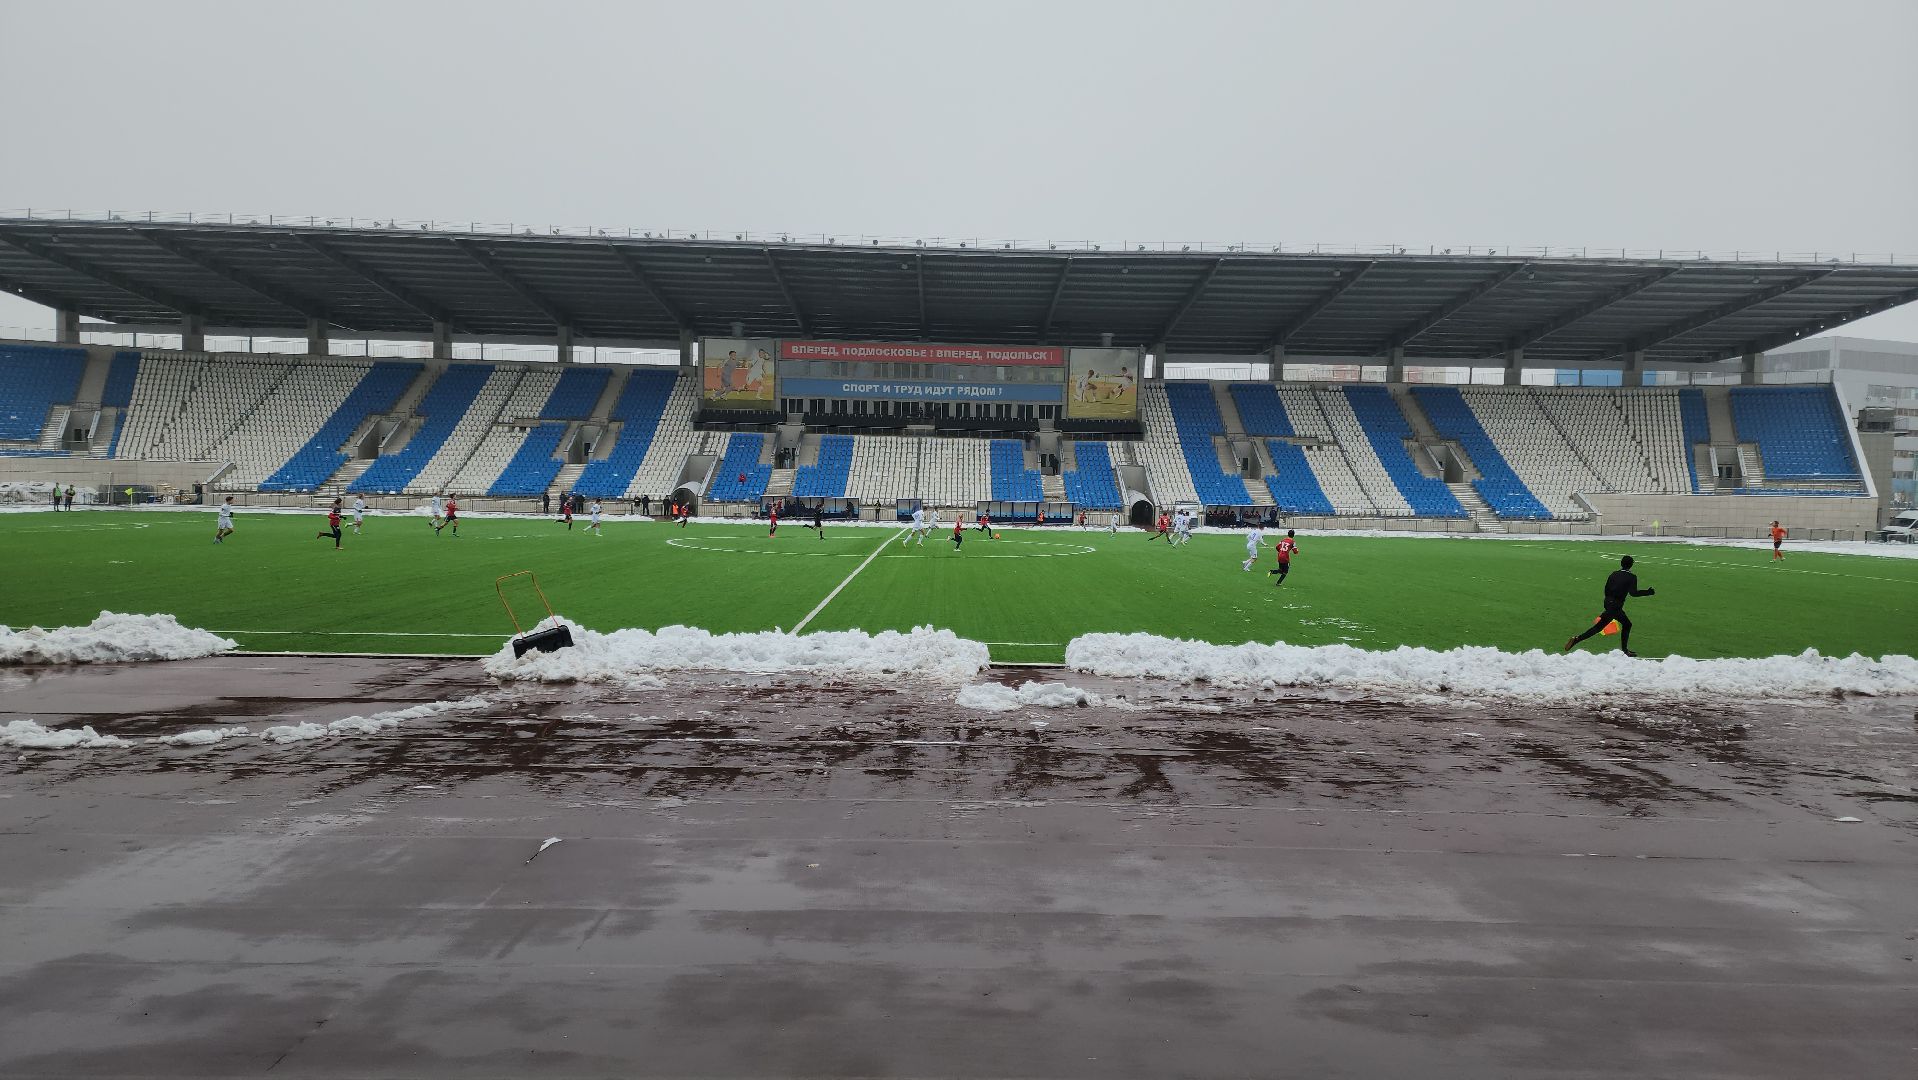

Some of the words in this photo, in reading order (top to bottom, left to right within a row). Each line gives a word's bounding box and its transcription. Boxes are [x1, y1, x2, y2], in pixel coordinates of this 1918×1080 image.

[843, 347, 926, 357] ПОДМОСКОВЬЕ
[937, 349, 982, 360] ВПЕРЕД,
[986, 351, 1047, 360] ПОДОЛЬСК
[842, 383, 879, 393] СПОРТ
[882, 385, 890, 393] И
[893, 385, 922, 395] ТРУД
[925, 386, 954, 396] ИДУТ
[957, 387, 995, 397] РЯДОМ
[1280, 541, 1290, 552] 13
